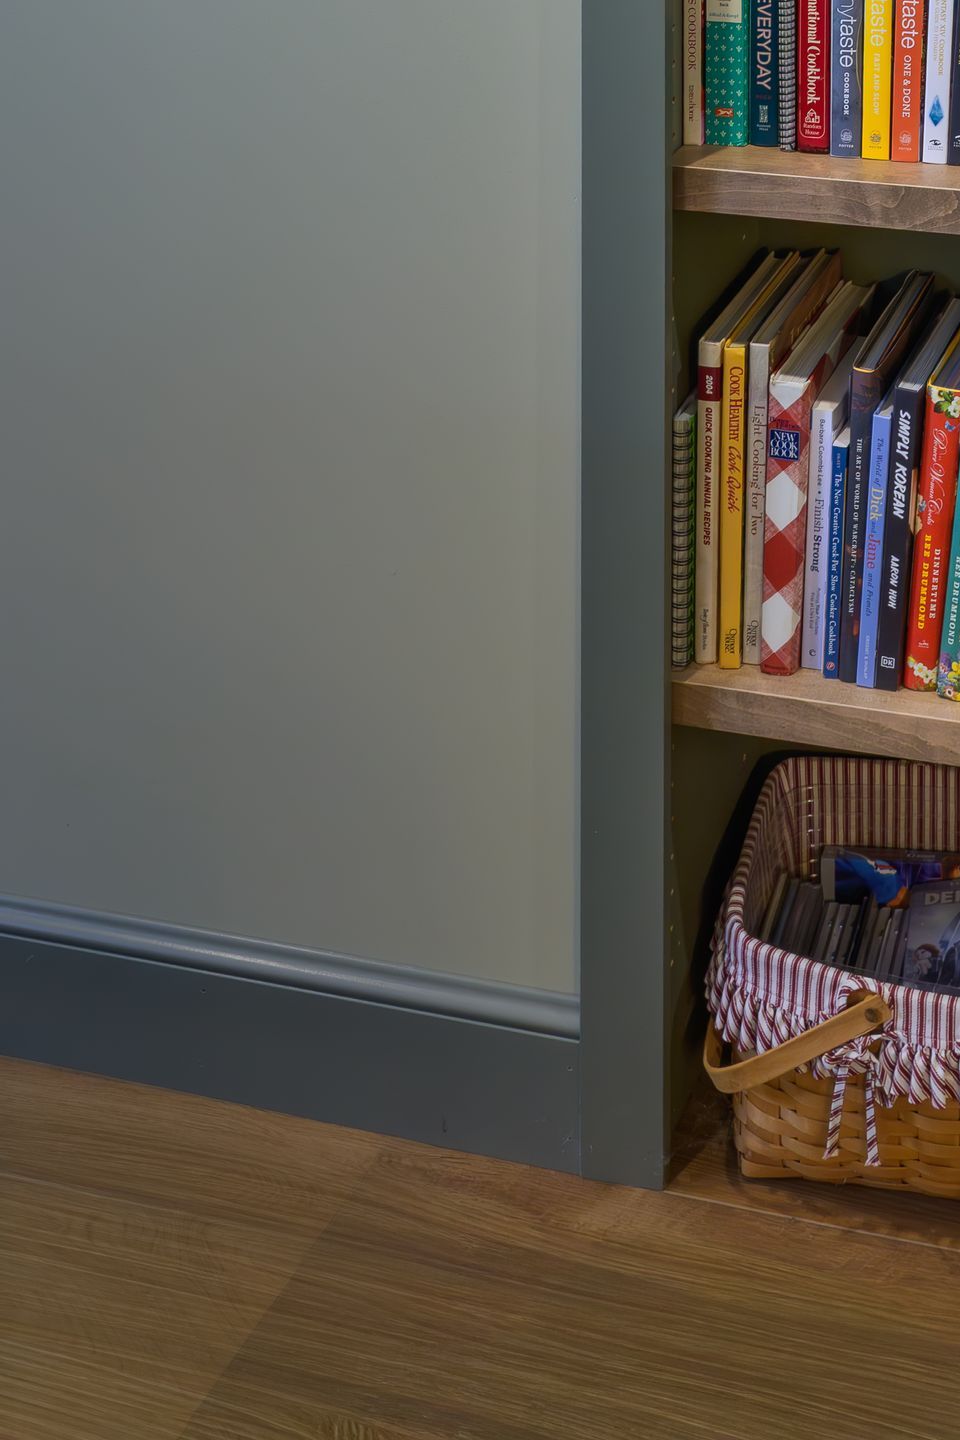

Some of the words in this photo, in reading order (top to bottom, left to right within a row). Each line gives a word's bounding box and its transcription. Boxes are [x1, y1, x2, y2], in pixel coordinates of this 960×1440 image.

[687, 6, 696, 71] COOKBOOK
[805, 45, 821, 105] Cookbook
[903, 55, 912, 77] ONE
[903, 77, 911, 86] &
[902, 87, 911, 119] DONE
[705, 374, 713, 396] 2004
[729, 366, 743, 396] COOK
[704, 406, 713, 435] QUICK
[728, 398, 743, 442] HEALTHY
[774, 430, 797, 440] NEW
[895, 410, 912, 461] SIMPLY
[703, 435, 712, 474] COOKING
[728, 446, 741, 474] Cook
[769, 448, 798, 459] BOOK
[770, 438, 798, 449] COOK
[702, 474, 712, 510] ANNUAL
[726, 475, 741, 514] Quick
[869, 487, 884, 521] Dick
[892, 463, 907, 520] KOREAN
[702, 511, 711, 546] RECIPES
[815, 499, 825, 532] Finish
[810, 533, 822, 573] Strong
[866, 533, 881, 570] Jane
[922, 534, 932, 558] REE
[888, 555, 900, 587] AARON
[928, 548, 942, 619] DINNERTIME
[887, 587, 898, 610] HUH
[917, 562, 931, 630] DRUMMOND
[947, 582, 960, 646] DRUMMOND
